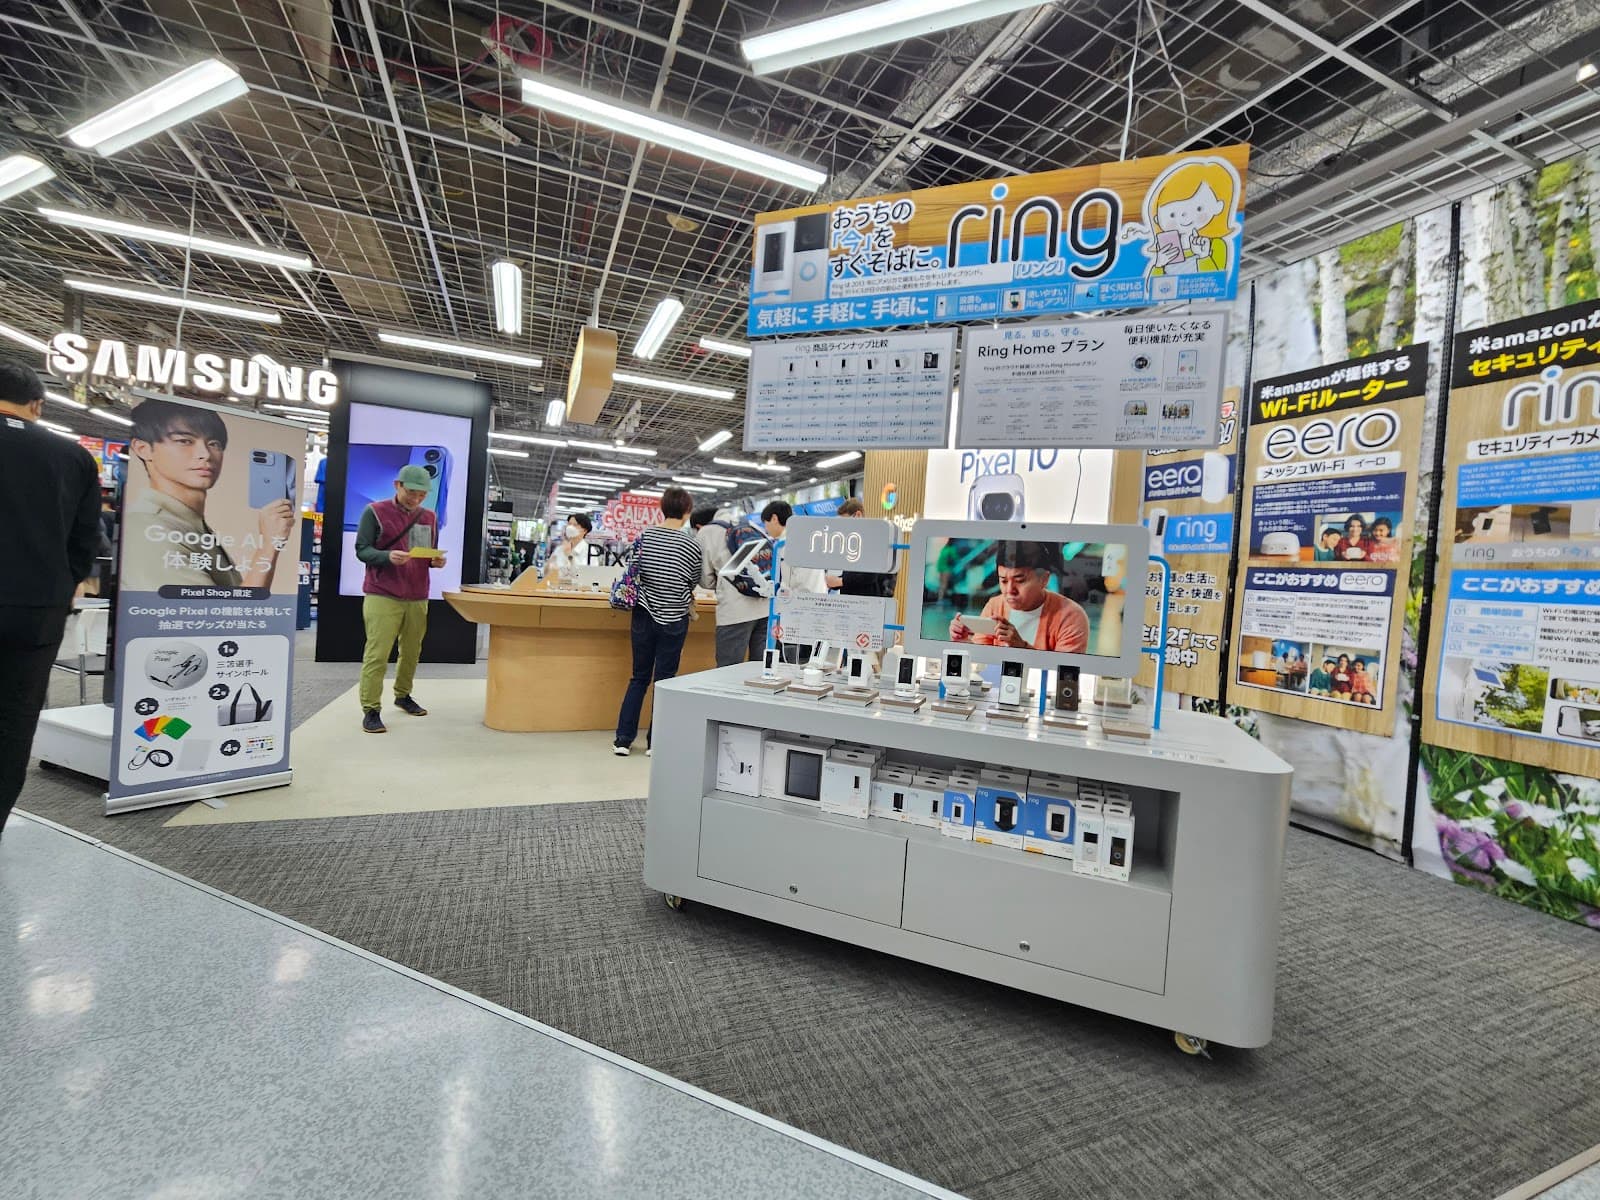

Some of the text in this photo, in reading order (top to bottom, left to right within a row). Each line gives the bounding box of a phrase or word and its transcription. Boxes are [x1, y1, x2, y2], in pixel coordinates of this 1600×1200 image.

[832, 201, 913, 230] おうちの
[831, 226, 895, 255] 「今」を
[947, 182, 1119, 279] ring
[831, 248, 940, 278] すぐそばに。
[757, 296, 929, 329] 気軽に 手軽に 手頃に
[1124, 320, 1211, 334] 毎日使いたくなる
[1128, 332, 1206, 346] 便利機能が充実
[812, 339, 889, 352] 商品ラインナップ比較
[978, 339, 1105, 359] Ring Home プラン
[50, 332, 339, 405] SAMSUNG
[1260, 355, 1412, 400] 米amazonが提供する
[1260, 378, 1409, 419] Wi-Fiルーター
[1266, 412, 1397, 460] eero
[1148, 464, 1202, 489] eero
[1263, 459, 1346, 479] メッシュWi-Fi
[143, 524, 289, 551] Google AI を
[1176, 517, 1218, 543] ring
[809, 525, 862, 561] ring
[1464, 546, 1496, 560] ring
[162, 551, 273, 573] 体験しよう
[1252, 572, 1384, 588] ここがおすすめ eero
[180, 588, 253, 600] Pixel Shop 限定
[128, 606, 292, 619] Google Pixel の機能を体験して
[158, 620, 267, 631] 抽選でグッズが当たる
